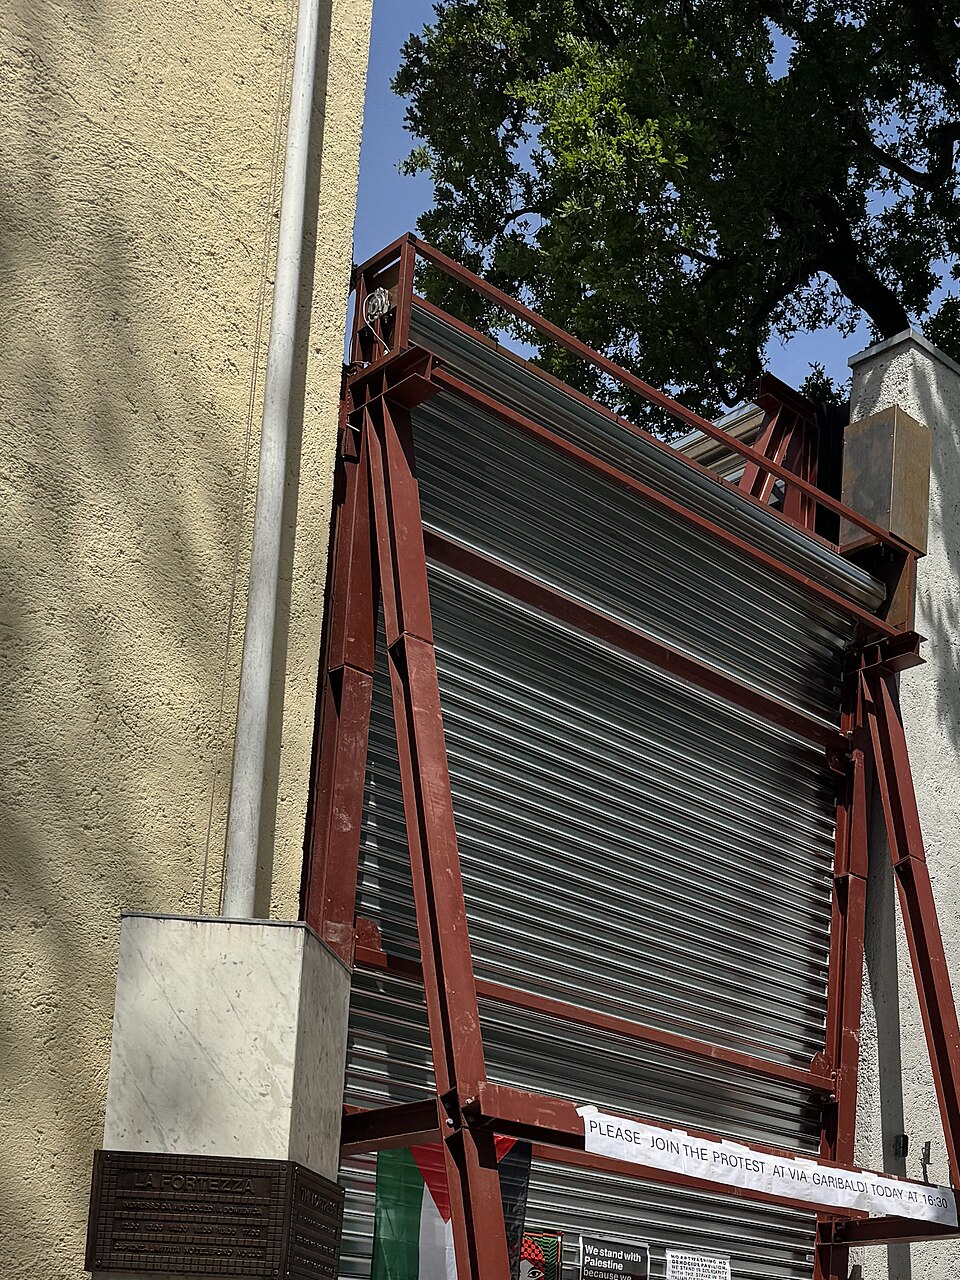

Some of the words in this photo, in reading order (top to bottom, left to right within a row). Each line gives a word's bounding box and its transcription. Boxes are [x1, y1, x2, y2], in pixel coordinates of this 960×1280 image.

[590, 1120, 641, 1144] PLEASE
[651, 1136, 679, 1154] JOIN
[683, 1144, 708, 1161] THE
[714, 1151, 765, 1173] PROTEST
[773, 1165, 785, 1178] AT
[788, 1168, 807, 1182] VIA
[813, 1173, 868, 1193] GARIBALDI
[871, 1185, 903, 1199] TODAY
[908, 1191, 918, 1202] AT
[922, 1194, 948, 1209] 16:30
[134, 1172, 156, 1188] LA
[160, 1174, 254, 1195] FORTEZZA
[585, 1245, 598, 1255] We
[600, 1248, 623, 1259] stand
[624, 1252, 641, 1262] with
[585, 1256, 623, 1270] Palestine
[584, 1267, 618, 1280] because
